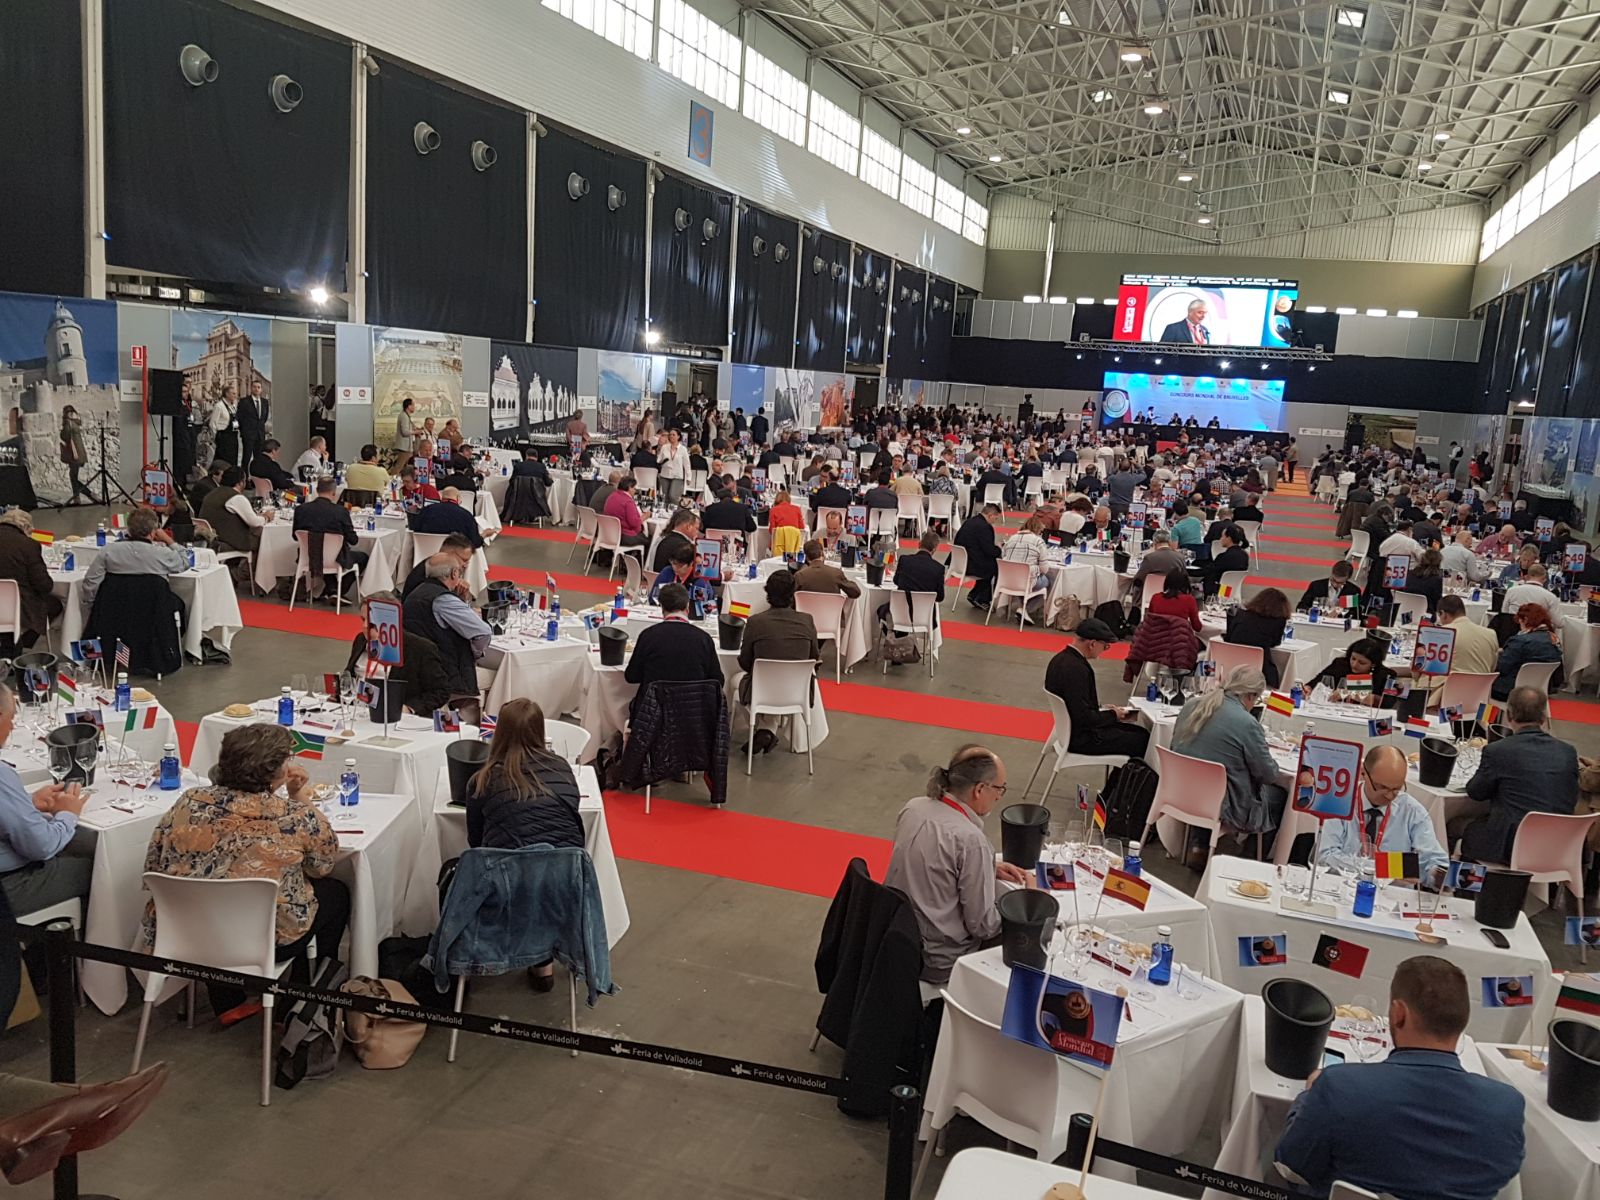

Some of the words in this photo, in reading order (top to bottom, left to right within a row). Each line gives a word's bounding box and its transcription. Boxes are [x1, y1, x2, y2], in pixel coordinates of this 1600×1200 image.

[442, 446, 449, 454] 52
[419, 467, 428, 478] 55
[152, 482, 166, 497] 58
[756, 478, 764, 486] 51
[1133, 512, 1144, 522] 50
[1502, 506, 1510, 514] 41
[854, 516, 865, 527] 54
[1540, 527, 1551, 536] 45
[702, 552, 718, 568] 57
[1570, 553, 1583, 564] 49
[1392, 566, 1406, 580] 53
[379, 625, 398, 648] 60
[1426, 642, 1449, 663] 56
[1316, 765, 1351, 798] 59
[183, 967, 200, 976] Feria
[210, 972, 244, 986] Valladolid
[288, 989, 305, 998] Feria
[306, 992, 316, 1000] de
[317, 993, 352, 1006] Valladolid
[396, 1008, 414, 1017] Feria
[426, 1012, 462, 1026] Valladolid
[512, 1028, 530, 1036] Feria
[542, 1032, 580, 1046] Valladolid
[1058, 1038, 1095, 1056] Mondial
[632, 1048, 652, 1058] Feria
[664, 1054, 702, 1066] Valladolid
[754, 1068, 773, 1079] Feria
[786, 1075, 826, 1089] Valladolid
[1202, 1173, 1224, 1186] Feria
[1226, 1180, 1239, 1190] de
[1241, 1182, 1288, 1200] Valladolid
